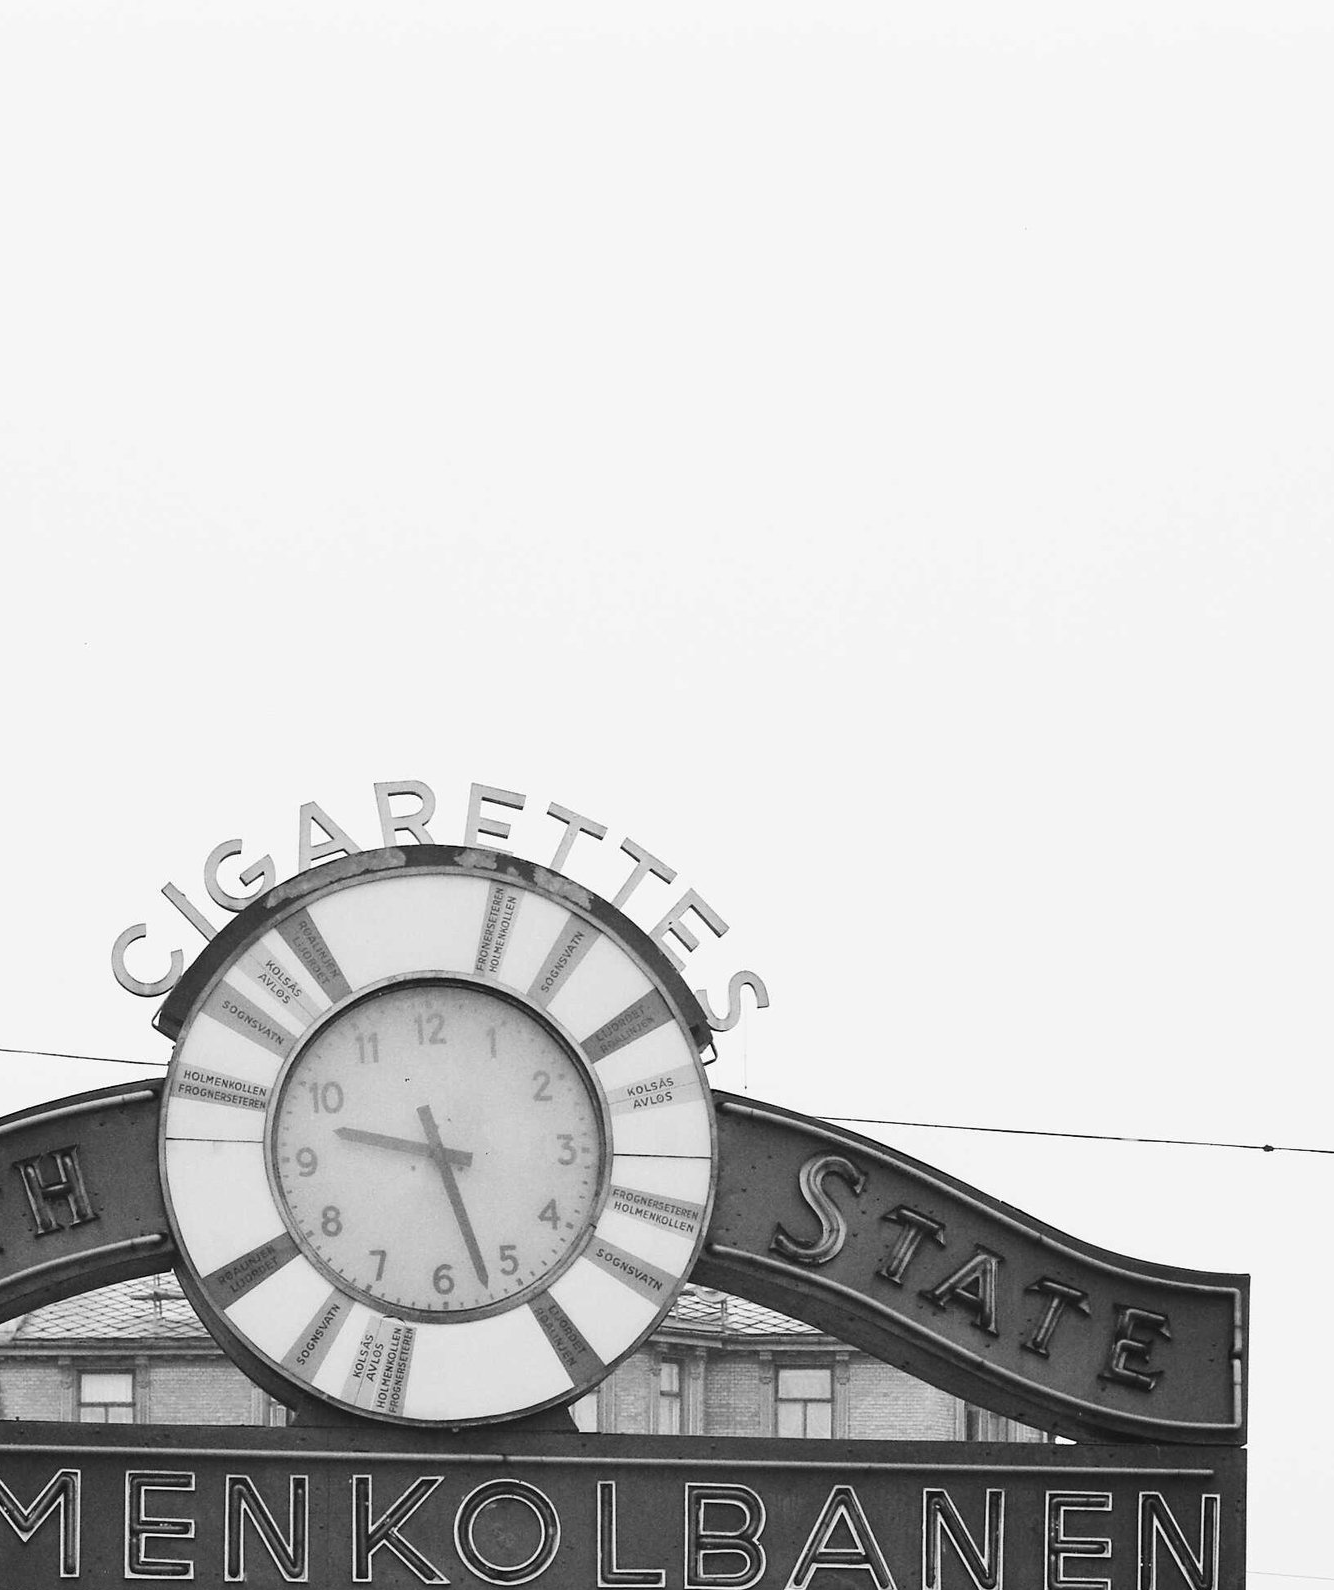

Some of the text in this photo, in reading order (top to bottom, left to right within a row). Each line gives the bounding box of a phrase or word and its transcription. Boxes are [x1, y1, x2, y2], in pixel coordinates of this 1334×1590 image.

[111, 780, 769, 1031] CIGARETTES
[489, 896, 516, 973] HOLMENKOLLEN
[541, 930, 585, 993] SOGNSVATN
[266, 960, 302, 997] KOLSÅS
[222, 1000, 285, 1046] SOGNSVATN
[416, 1013, 447, 1045] 12
[355, 1032, 379, 1064] 11
[487, 1027, 497, 1059] 1
[178, 1084, 266, 1110] FROGNERSETEREN
[183, 1070, 267, 1096] HOLMENKOLLEN
[309, 1081, 344, 1114] 10
[532, 1070, 553, 1102] 2
[627, 1077, 674, 1096] KOLSÅS
[296, 1147, 318, 1177] 9
[557, 1133, 578, 1166] 3
[537, 1198, 561, 1230] 4
[612, 1189, 699, 1220] FROGNERSETEREN
[614, 1201, 694, 1233] HOLMENKOLLEN
[321, 1205, 343, 1237] 8
[369, 1249, 387, 1281] 7
[499, 1244, 519, 1276] 5
[596, 1249, 663, 1291] SOGNSVATN
[769, 1152, 1171, 1391] STATE
[432, 1264, 455, 1295] 6
[296, 1303, 341, 1365] SOGNSVATN
[353, 1334, 374, 1378] KOLSÅS
[377, 1327, 402, 1408] HOLMENKOLLEN
[389, 1328, 413, 1413] FROGNERSETEREN
